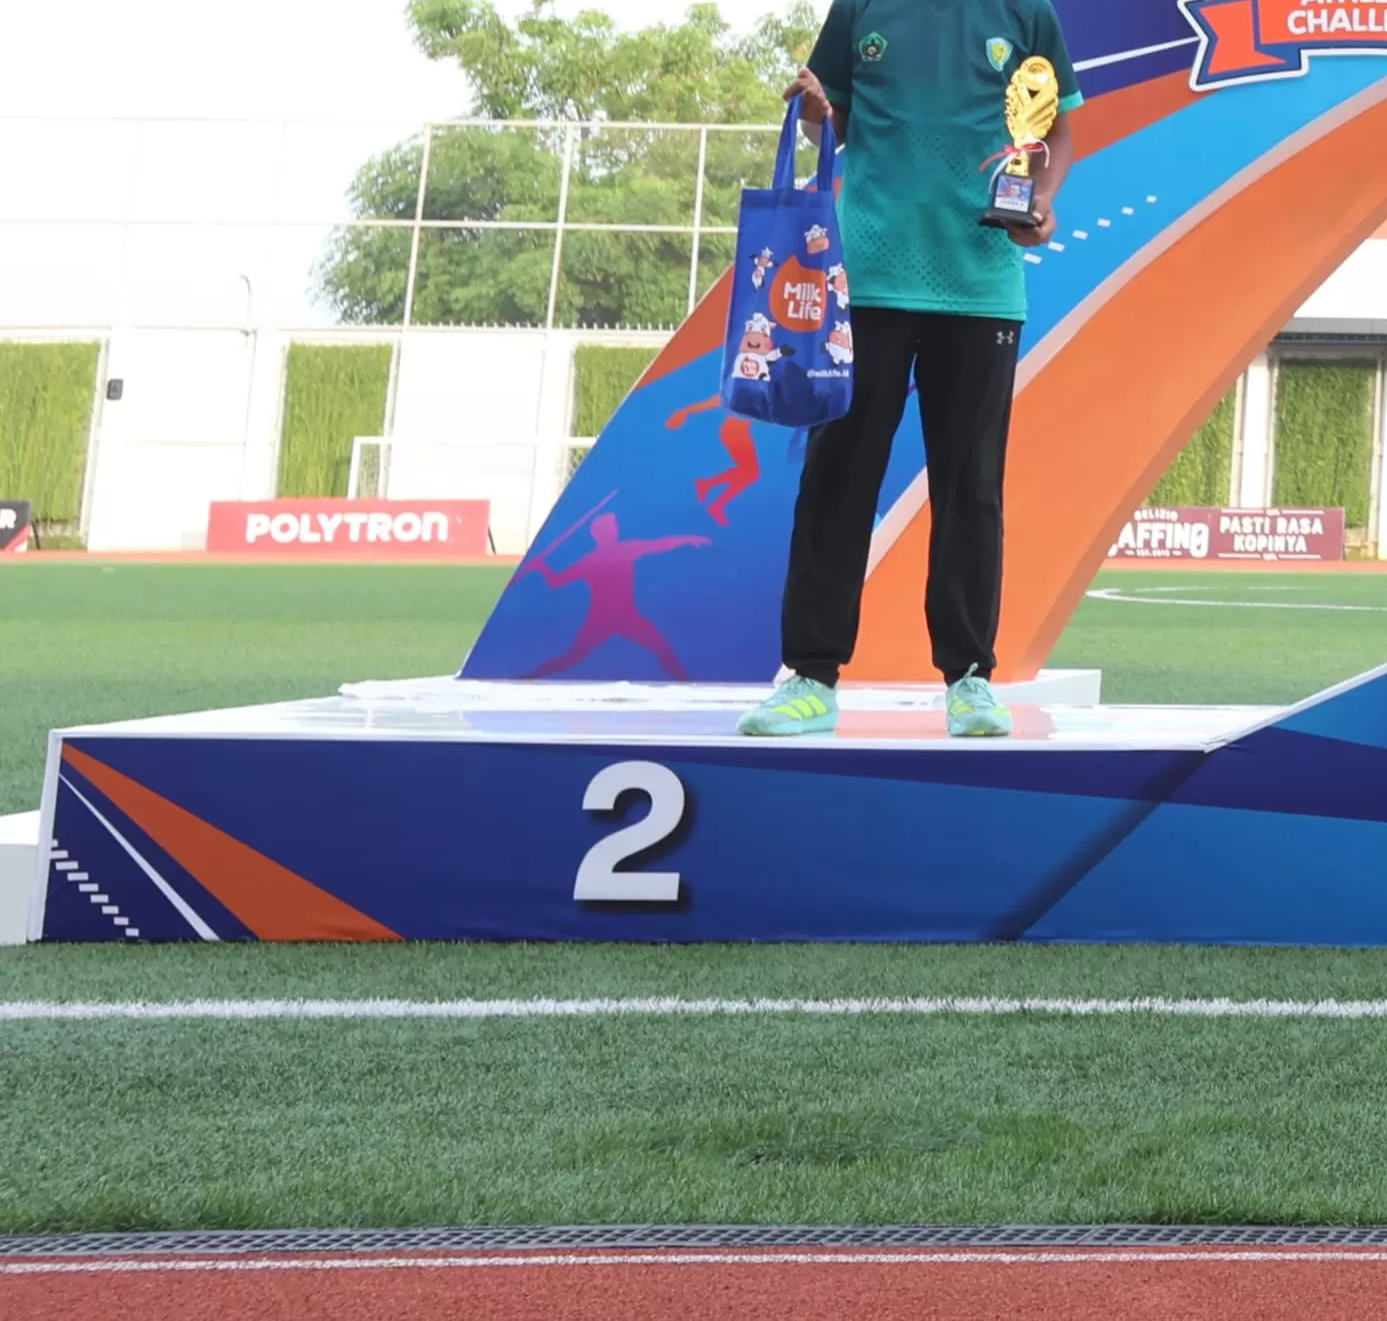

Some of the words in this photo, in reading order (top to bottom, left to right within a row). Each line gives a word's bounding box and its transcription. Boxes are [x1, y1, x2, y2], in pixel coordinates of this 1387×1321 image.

[783, 281, 822, 303] Milk
[787, 300, 822, 320] Life
[1219, 516, 1271, 535] PASTI
[1275, 517, 1325, 535] RASA
[1107, 522, 1210, 558] AFFINO
[1233, 535, 1308, 553] KOPINYA
[573, 760, 685, 901] 2
